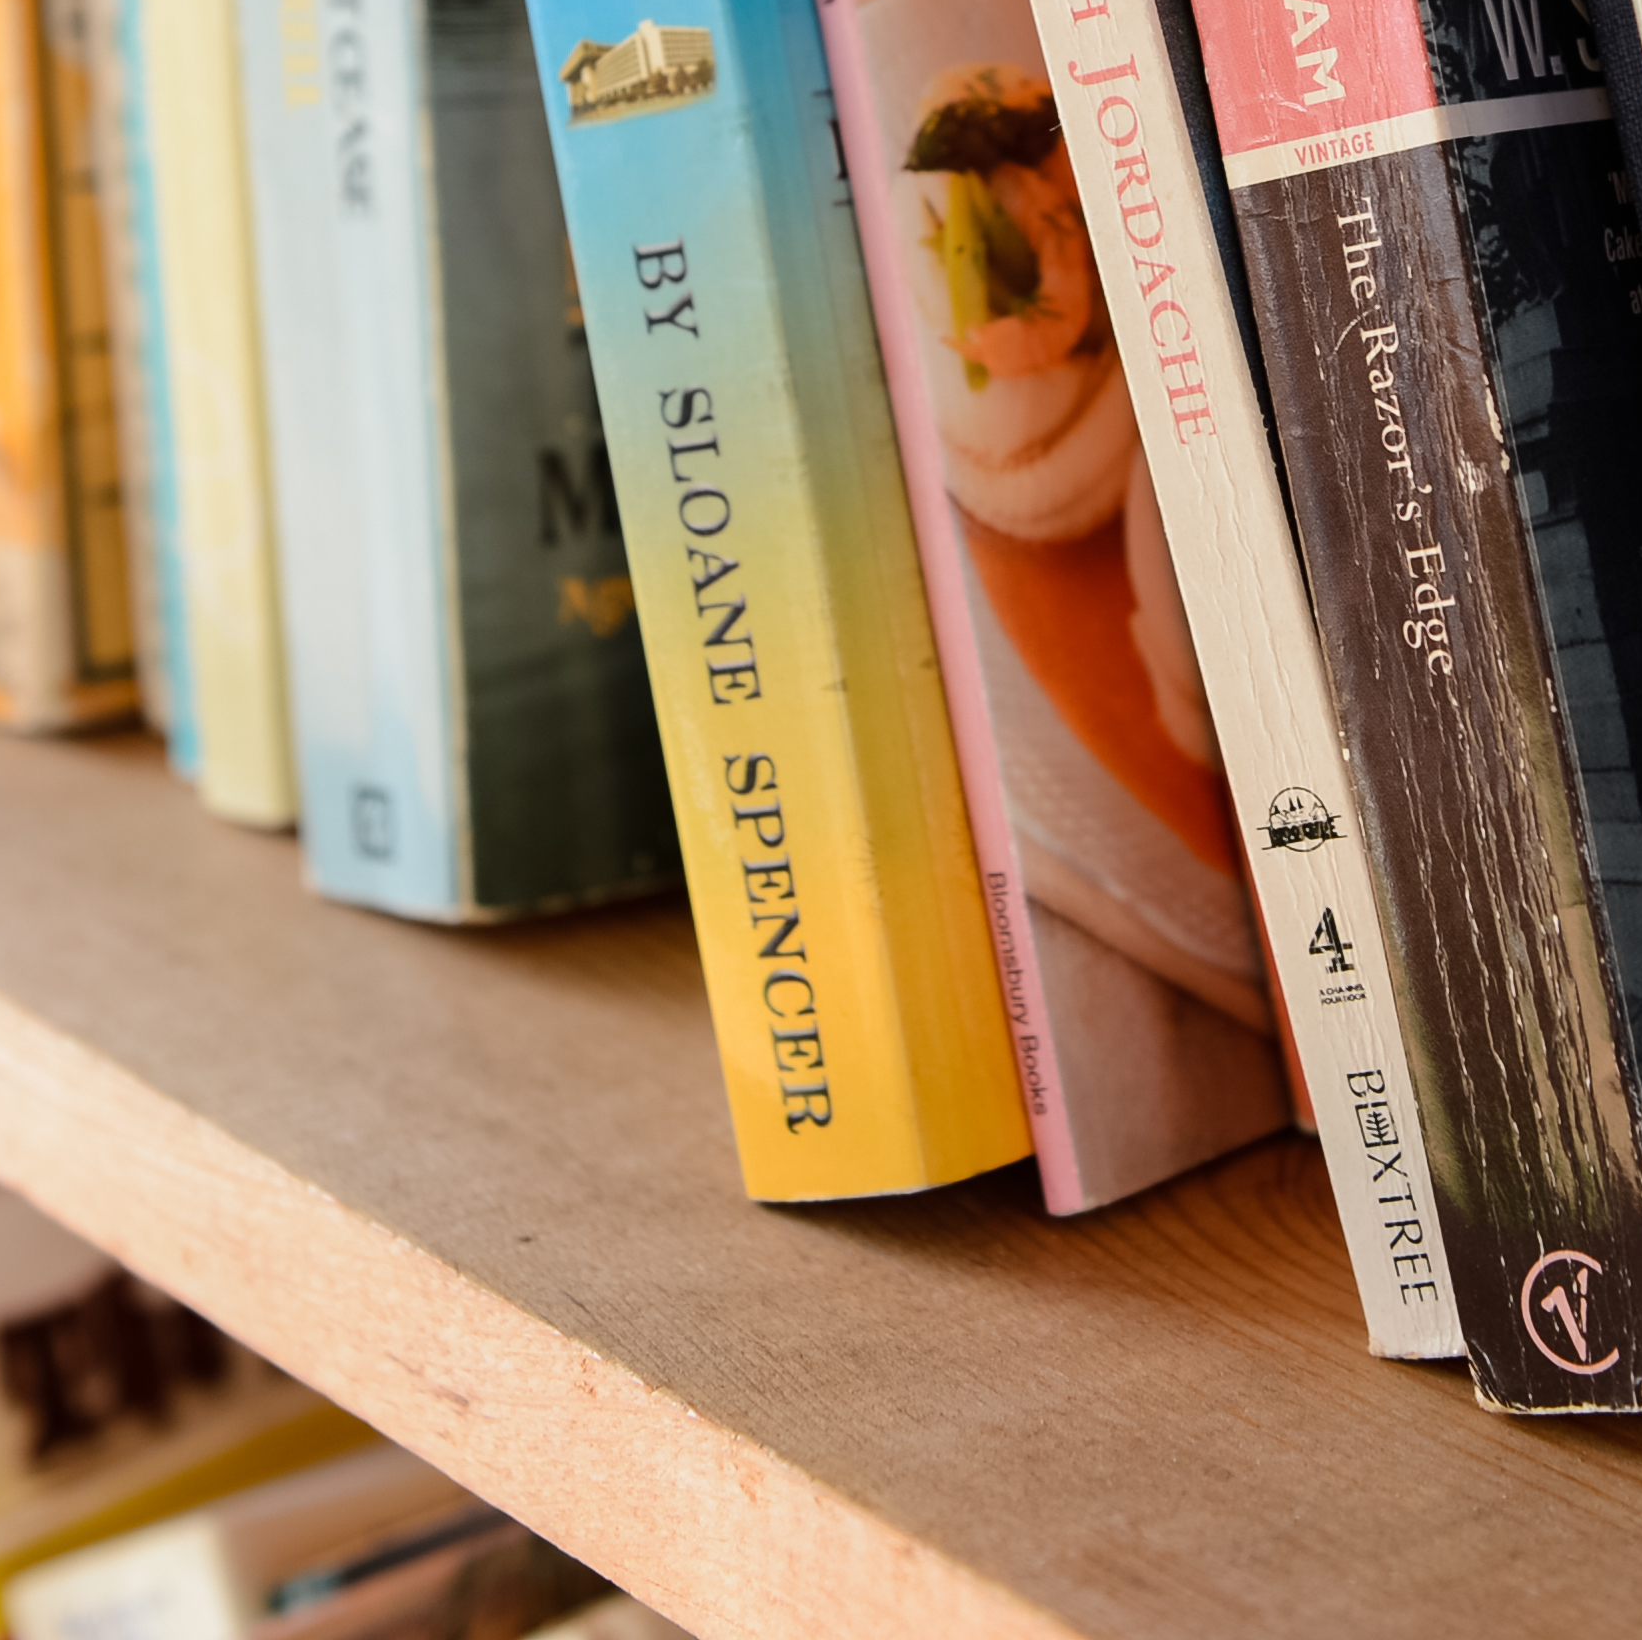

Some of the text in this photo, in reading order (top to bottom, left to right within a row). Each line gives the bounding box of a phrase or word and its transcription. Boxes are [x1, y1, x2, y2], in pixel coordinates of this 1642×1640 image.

[1068, 54, 1215, 446] JORDACHE
[1294, 132, 1375, 166] VINTAGE
[1336, 194, 1457, 677] The Razor's Edge
[633, 236, 832, 1136] BY SLOANE SPENCER
[987, 871, 1048, 1117] Bloomsbury Books
[1309, 907, 1355, 973] 4
